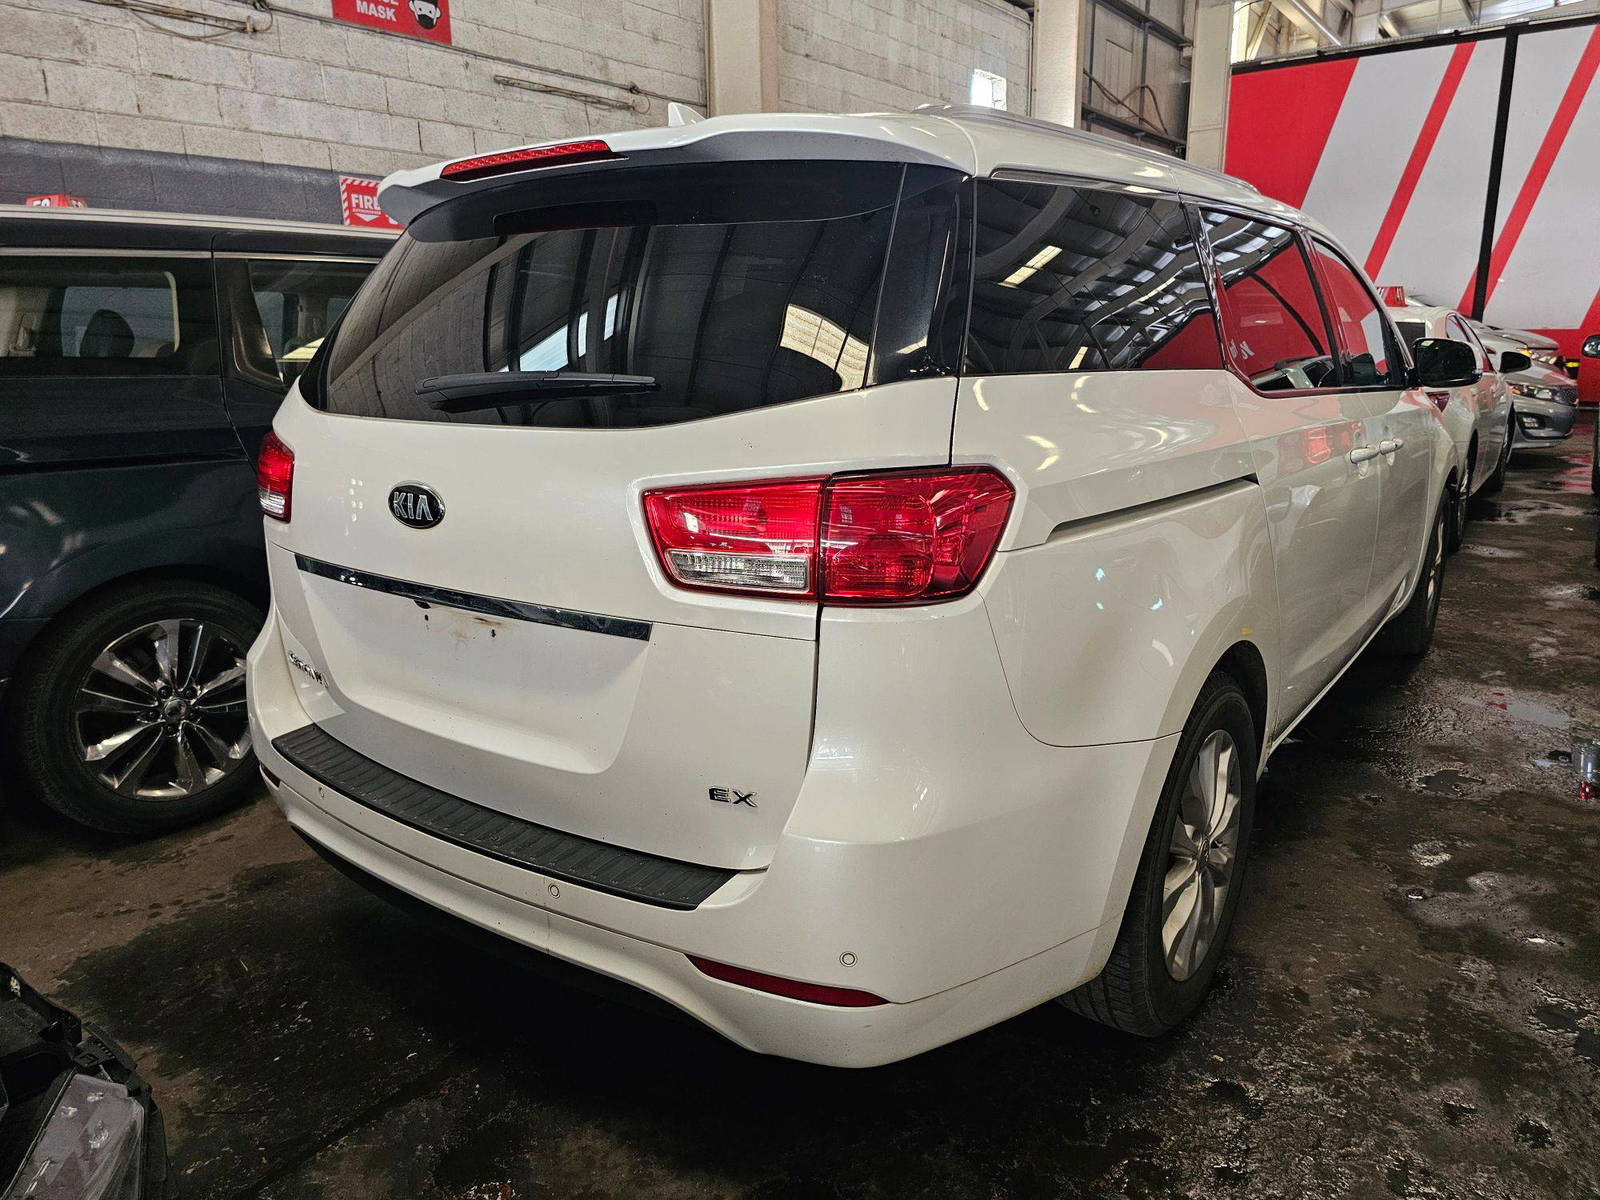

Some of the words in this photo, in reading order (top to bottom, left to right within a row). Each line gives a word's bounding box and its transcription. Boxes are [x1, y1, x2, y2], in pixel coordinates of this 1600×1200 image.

[356, 0, 397, 22] MASK
[393, 491, 433, 520] KIA
[708, 787, 758, 808] EX
